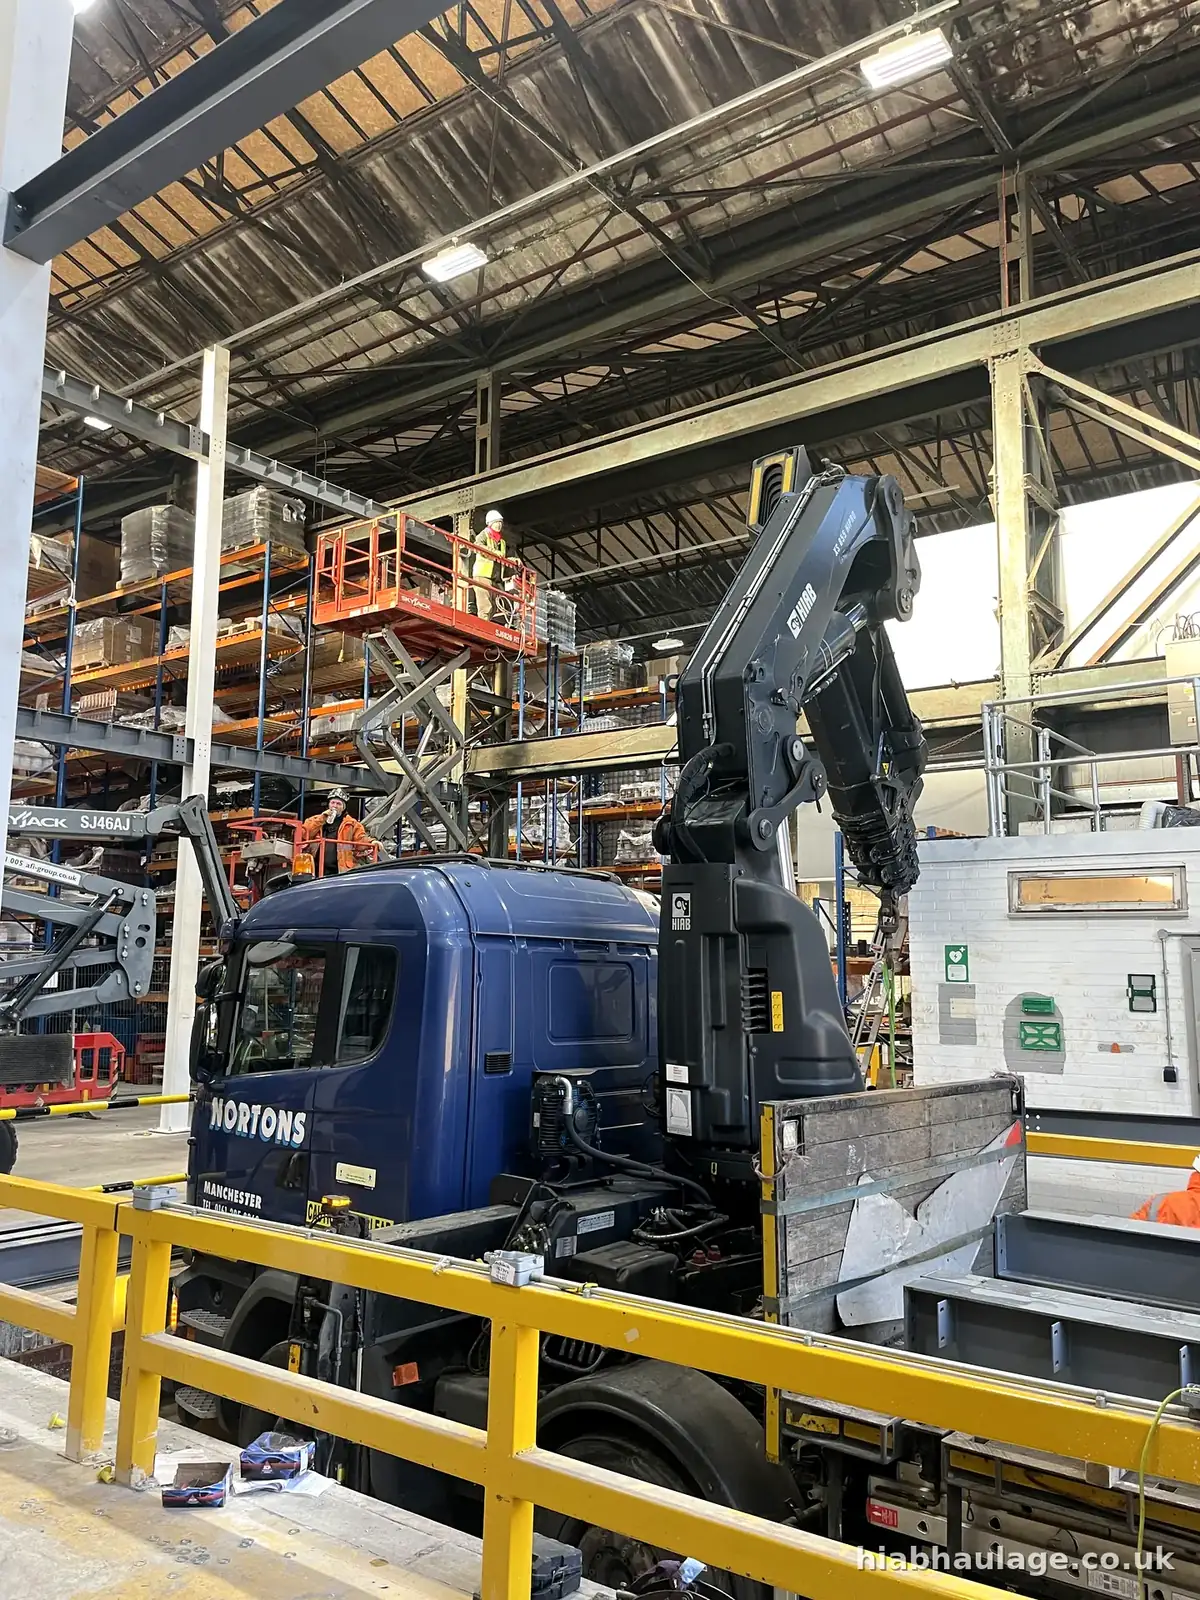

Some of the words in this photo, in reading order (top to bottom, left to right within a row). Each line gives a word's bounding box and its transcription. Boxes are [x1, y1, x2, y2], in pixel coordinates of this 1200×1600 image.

[795, 582, 817, 623] HIAB
[8, 811, 68, 828] YJACK
[80, 815, 130, 831] SJ46AJ
[25, 862, 77, 882] afi-group.co.uk
[671, 918, 691, 931] HIAB
[210, 1097, 307, 1147] NORTONS
[203, 1180, 262, 1210] MANCHESTER
